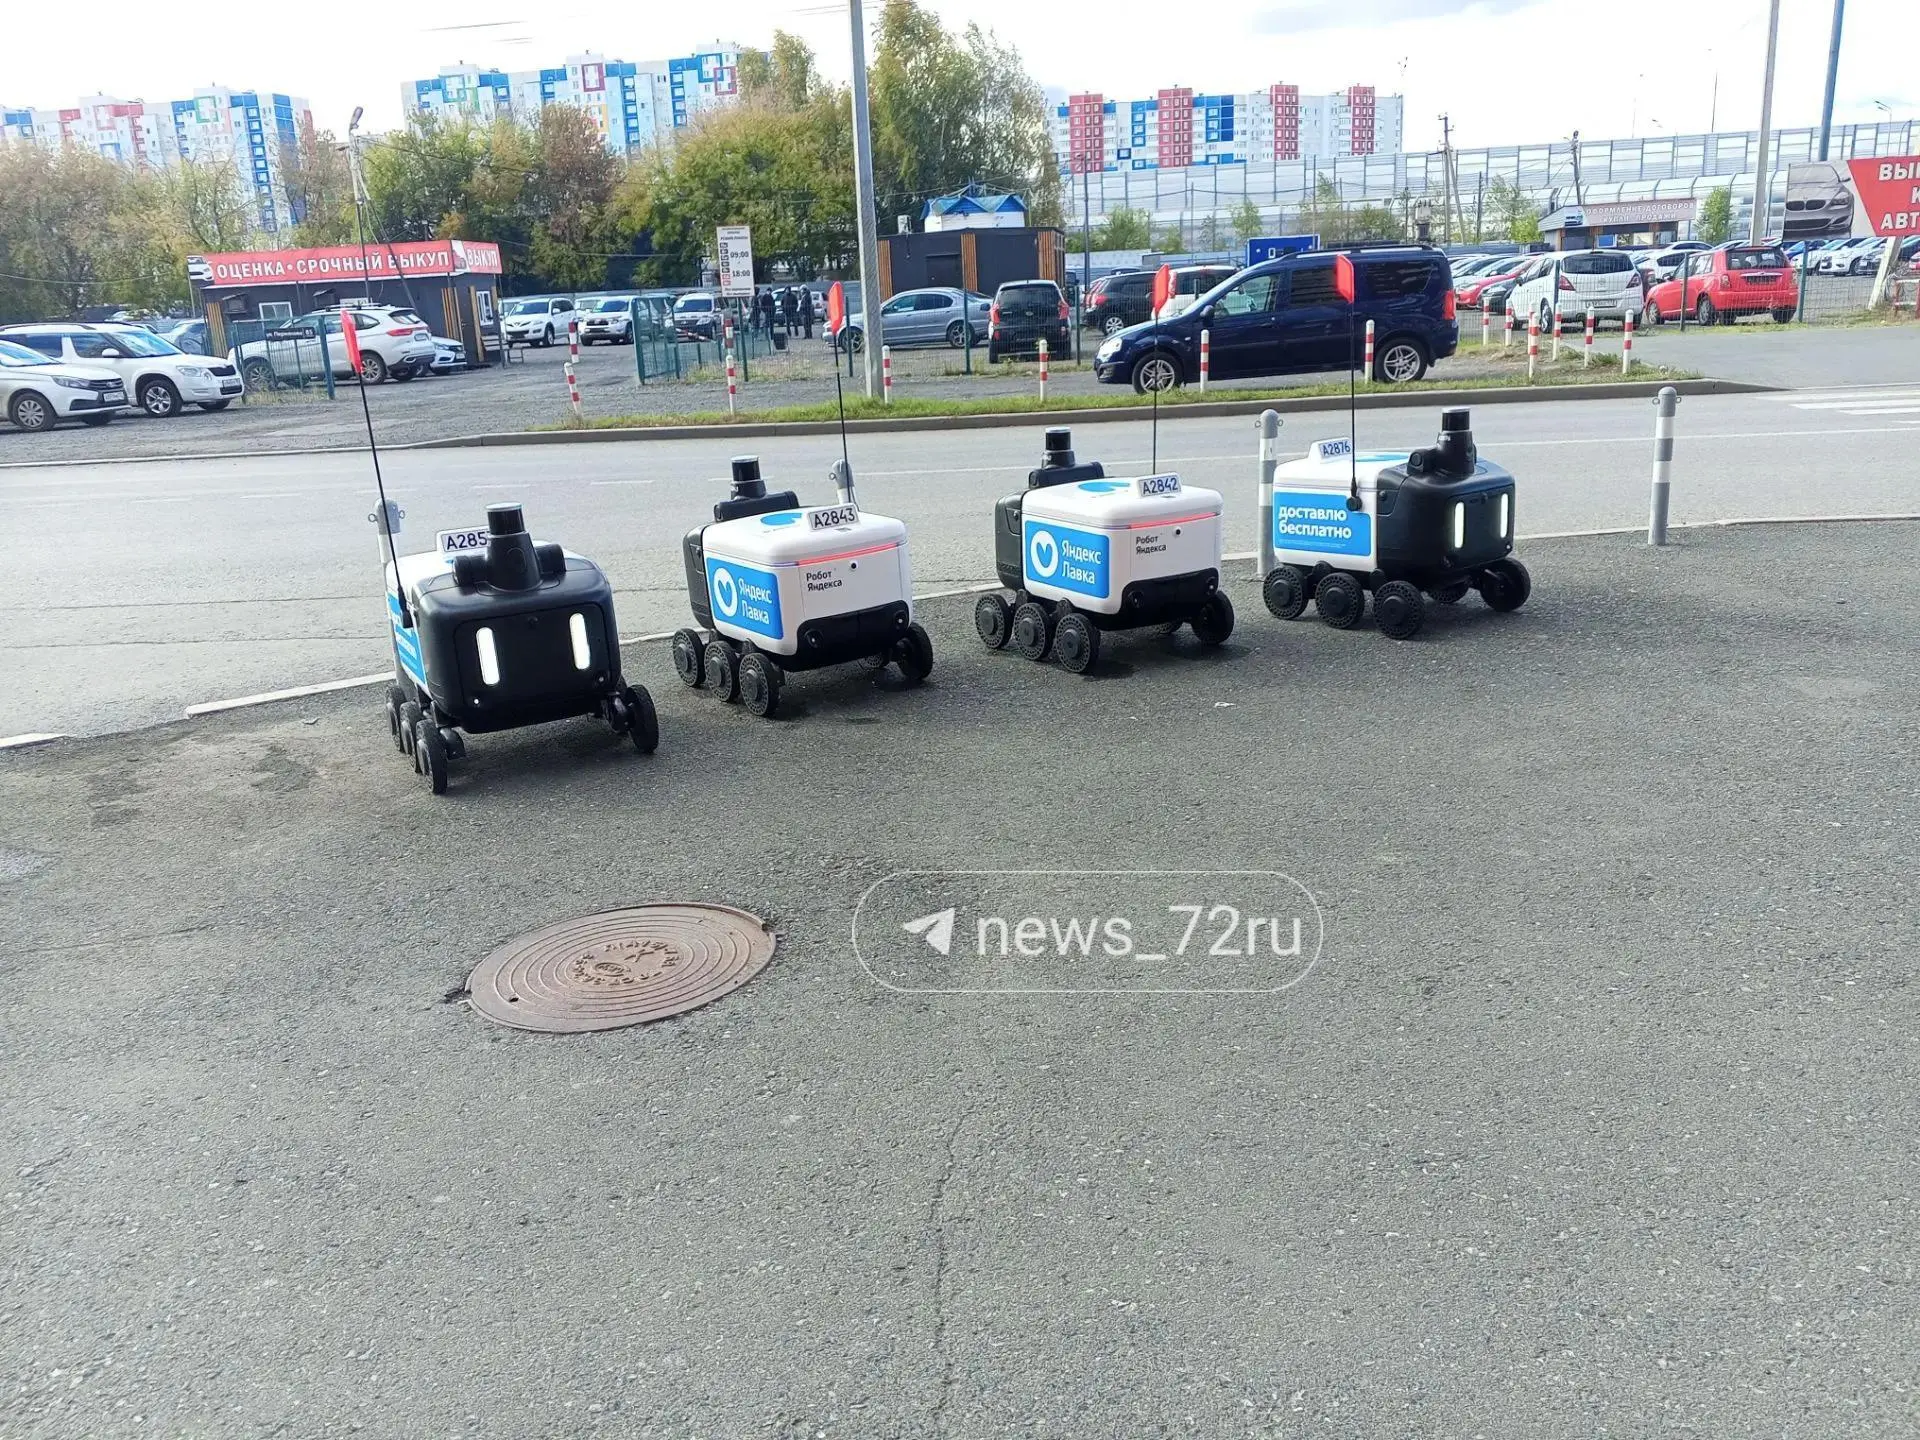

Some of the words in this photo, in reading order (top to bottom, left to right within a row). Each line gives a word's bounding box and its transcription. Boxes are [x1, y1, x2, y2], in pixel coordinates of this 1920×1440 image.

[1645, 202, 1694, 212] ДОГОВОРОВ
[217, 257, 286, 280] ОЦЕНКА
[297, 251, 383, 275] СРОЧНЫЙ
[387, 250, 450, 271] ВЫКУП
[467, 249, 499, 267] ВЫКУП
[1279, 506, 1347, 522] доставлю
[1279, 516, 1352, 539] бесплатно
[446, 531, 490, 550] A285
[1136, 535, 1158, 545] Робот
[1062, 540, 1102, 565] Яндекс
[1136, 544, 1167, 556] Яндекса
[806, 570, 832, 582] Робот
[1062, 561, 1095, 585] Лавка
[738, 577, 773, 604] Яндекс
[807, 578, 842, 592] Яндекса
[741, 600, 770, 625] Лавка
